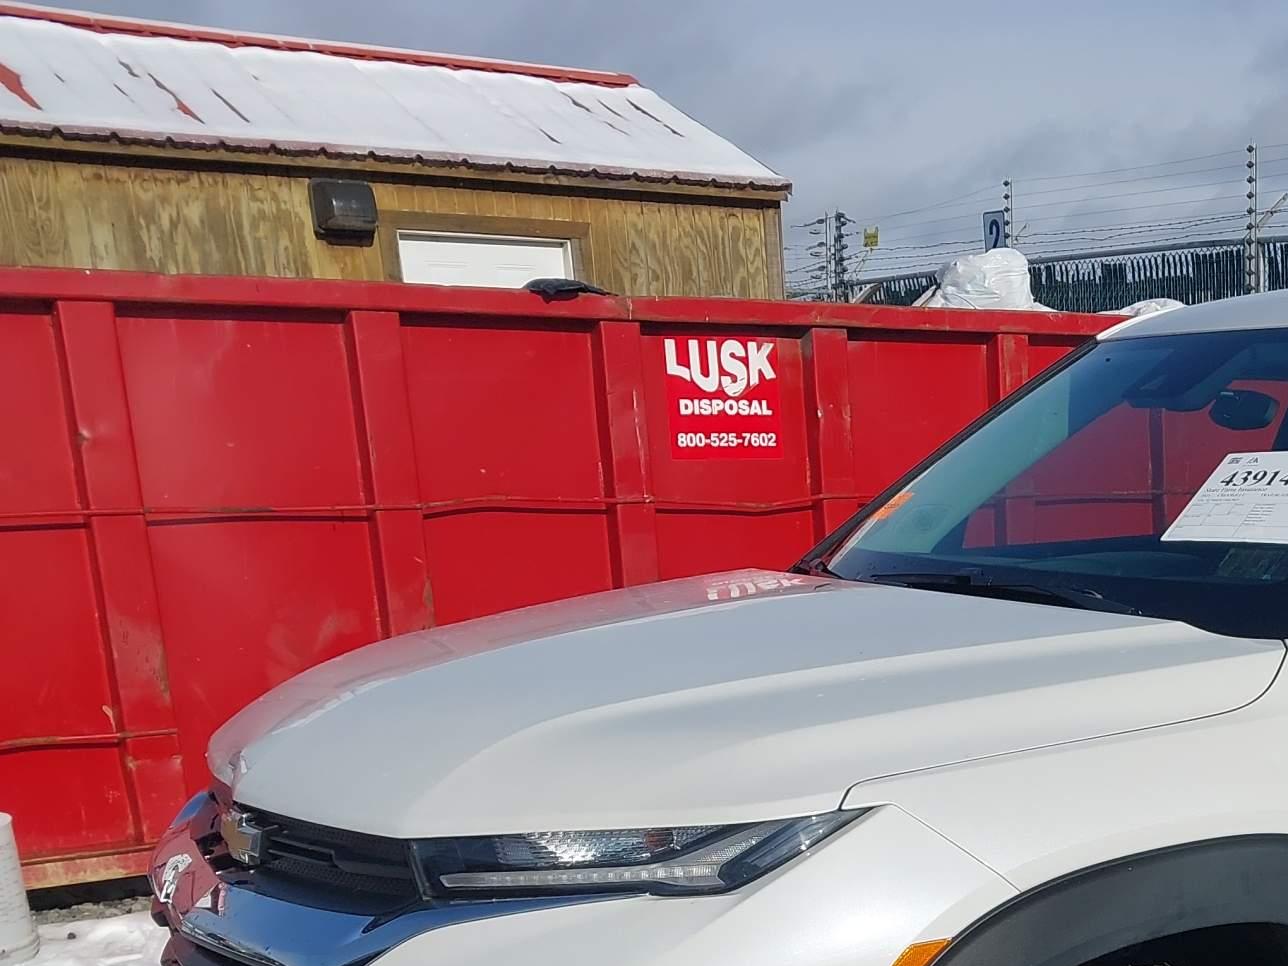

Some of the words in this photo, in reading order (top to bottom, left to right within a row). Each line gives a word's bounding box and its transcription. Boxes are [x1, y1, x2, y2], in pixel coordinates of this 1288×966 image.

[664, 339, 777, 397] LUSK
[679, 399, 772, 415] DISPOSAL
[677, 433, 777, 447] 800-525-7602
